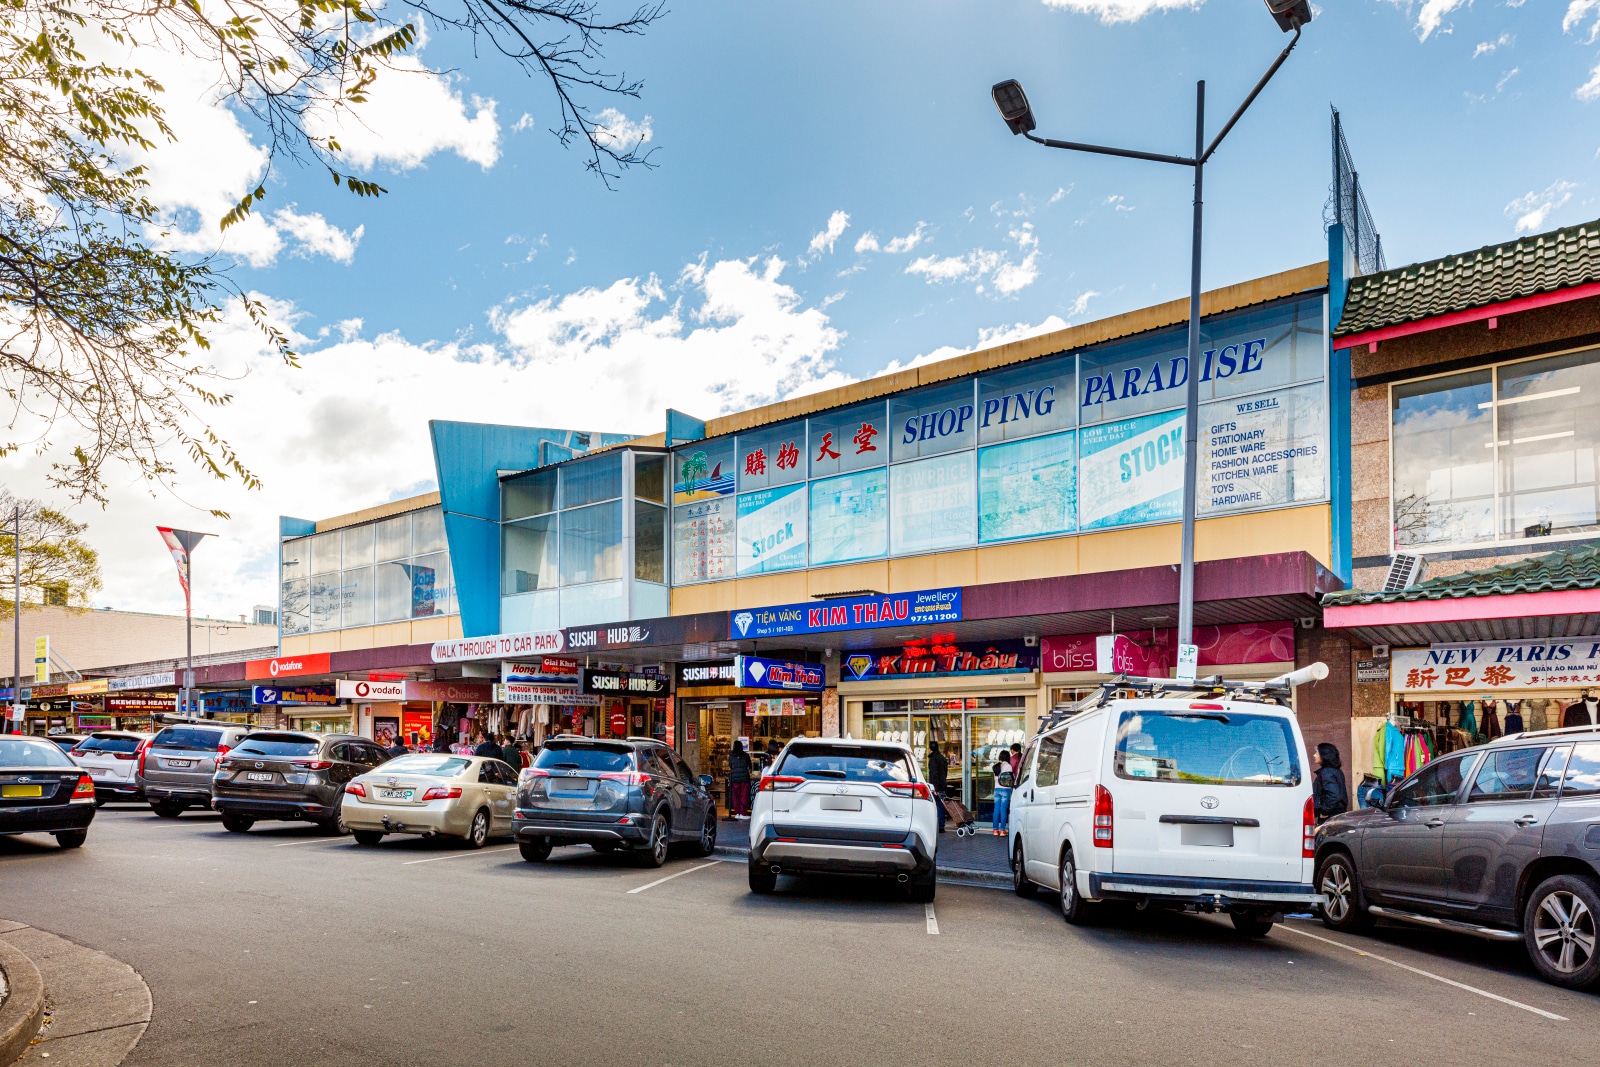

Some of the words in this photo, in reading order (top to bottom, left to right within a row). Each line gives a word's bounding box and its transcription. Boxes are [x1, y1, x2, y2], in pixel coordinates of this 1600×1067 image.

[903, 386, 1055, 444] SHOPPING
[1082, 338, 1266, 407] PARADISE
[1237, 403, 1252, 412] WE
[1255, 398, 1278, 409] SELL
[1083, 429, 1103, 438] LOW
[1108, 422, 1136, 434] PRICE
[1211, 422, 1236, 434] GIFTS
[1083, 435, 1107, 445] EVERY
[1110, 432, 1125, 440] DAY
[1211, 429, 1265, 446] STATIONARY
[745, 423, 879, 476] 購物天堂
[1120, 426, 1184, 483] STOCK
[1212, 447, 1240, 458] HOME
[1240, 442, 1265, 453] WARE
[1212, 457, 1248, 470] FASHION
[1252, 446, 1318, 464] ACCESSORIES
[928, 463, 967, 483] PRICE
[1212, 469, 1249, 482] KITCHEN
[1252, 464, 1278, 476] WARE
[754, 492, 772, 500] PRICE
[1212, 483, 1234, 494] TOYS
[1150, 500, 1177, 508] Cheap
[1212, 492, 1262, 506] HARDWARE
[413, 572, 435, 586] Jobs
[329, 591, 355, 600] Worforce
[916, 592, 957, 603] Jewellery
[329, 602, 352, 610] Austalia
[808, 606, 848, 628] KIM
[569, 631, 596, 647] SUSHI
[607, 627, 628, 644] HUB
[436, 644, 456, 658] WALK
[459, 640, 496, 656] THROUGH
[500, 639, 510, 653] TO
[515, 636, 531, 652] CAR
[535, 634, 558, 649] PARK
[1053, 649, 1094, 668] bliss
[1117, 649, 1134, 671] bliss
[1424, 648, 1485, 665] NEW
[1495, 644, 1573, 662] PARIS
[279, 661, 302, 671] vodafone
[512, 664, 536, 674] Hong
[878, 654, 936, 675] Kim
[683, 667, 709, 680] SUSHI
[769, 667, 792, 682] Kim
[1405, 665, 1516, 689] 新巴黎
[592, 676, 619, 690] SUSHI
[628, 678, 646, 691] HUB
[282, 691, 305, 701] Kim
[448, 686, 479, 699] Choice
